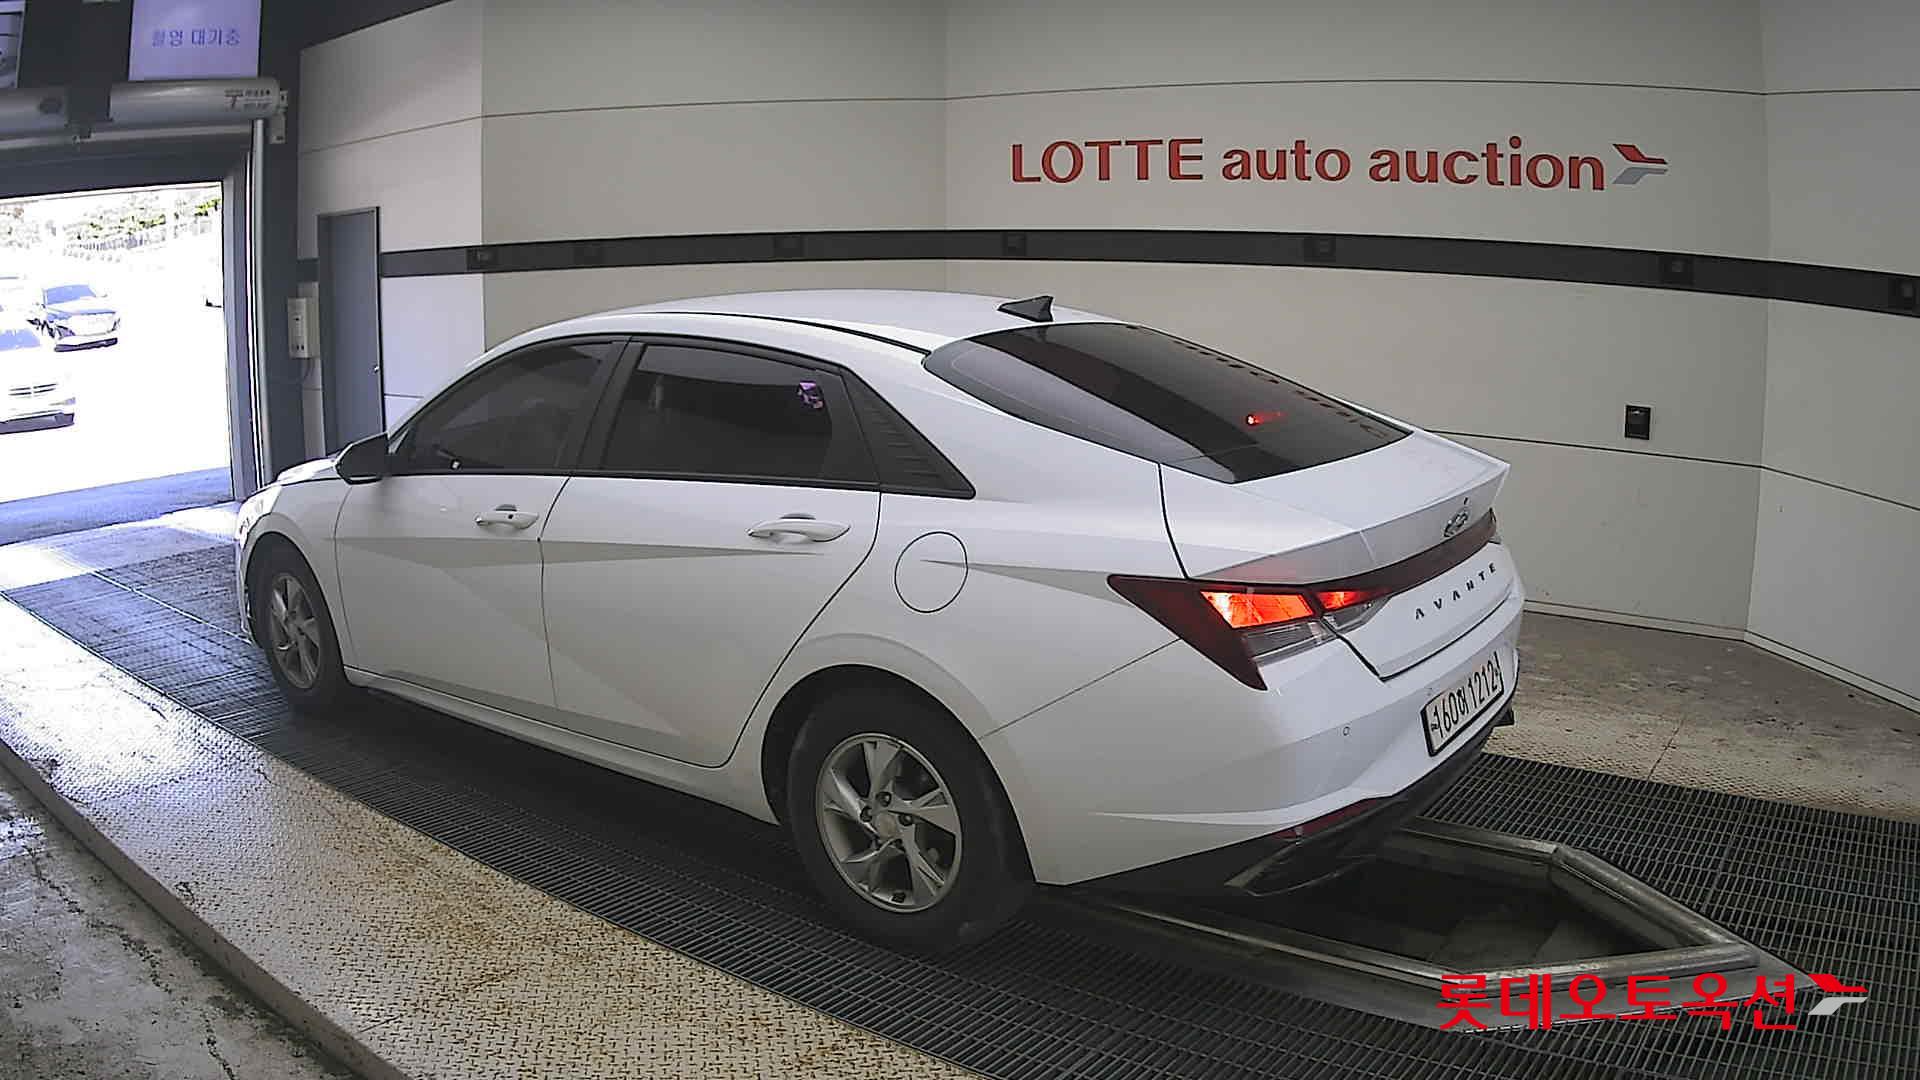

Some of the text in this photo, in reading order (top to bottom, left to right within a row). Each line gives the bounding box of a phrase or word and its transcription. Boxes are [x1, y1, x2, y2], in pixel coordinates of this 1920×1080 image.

[191, 27, 240, 46] 대기중
[1011, 136, 1605, 190] LOTTE auto auction
[1415, 562, 1496, 620] AVANTE
